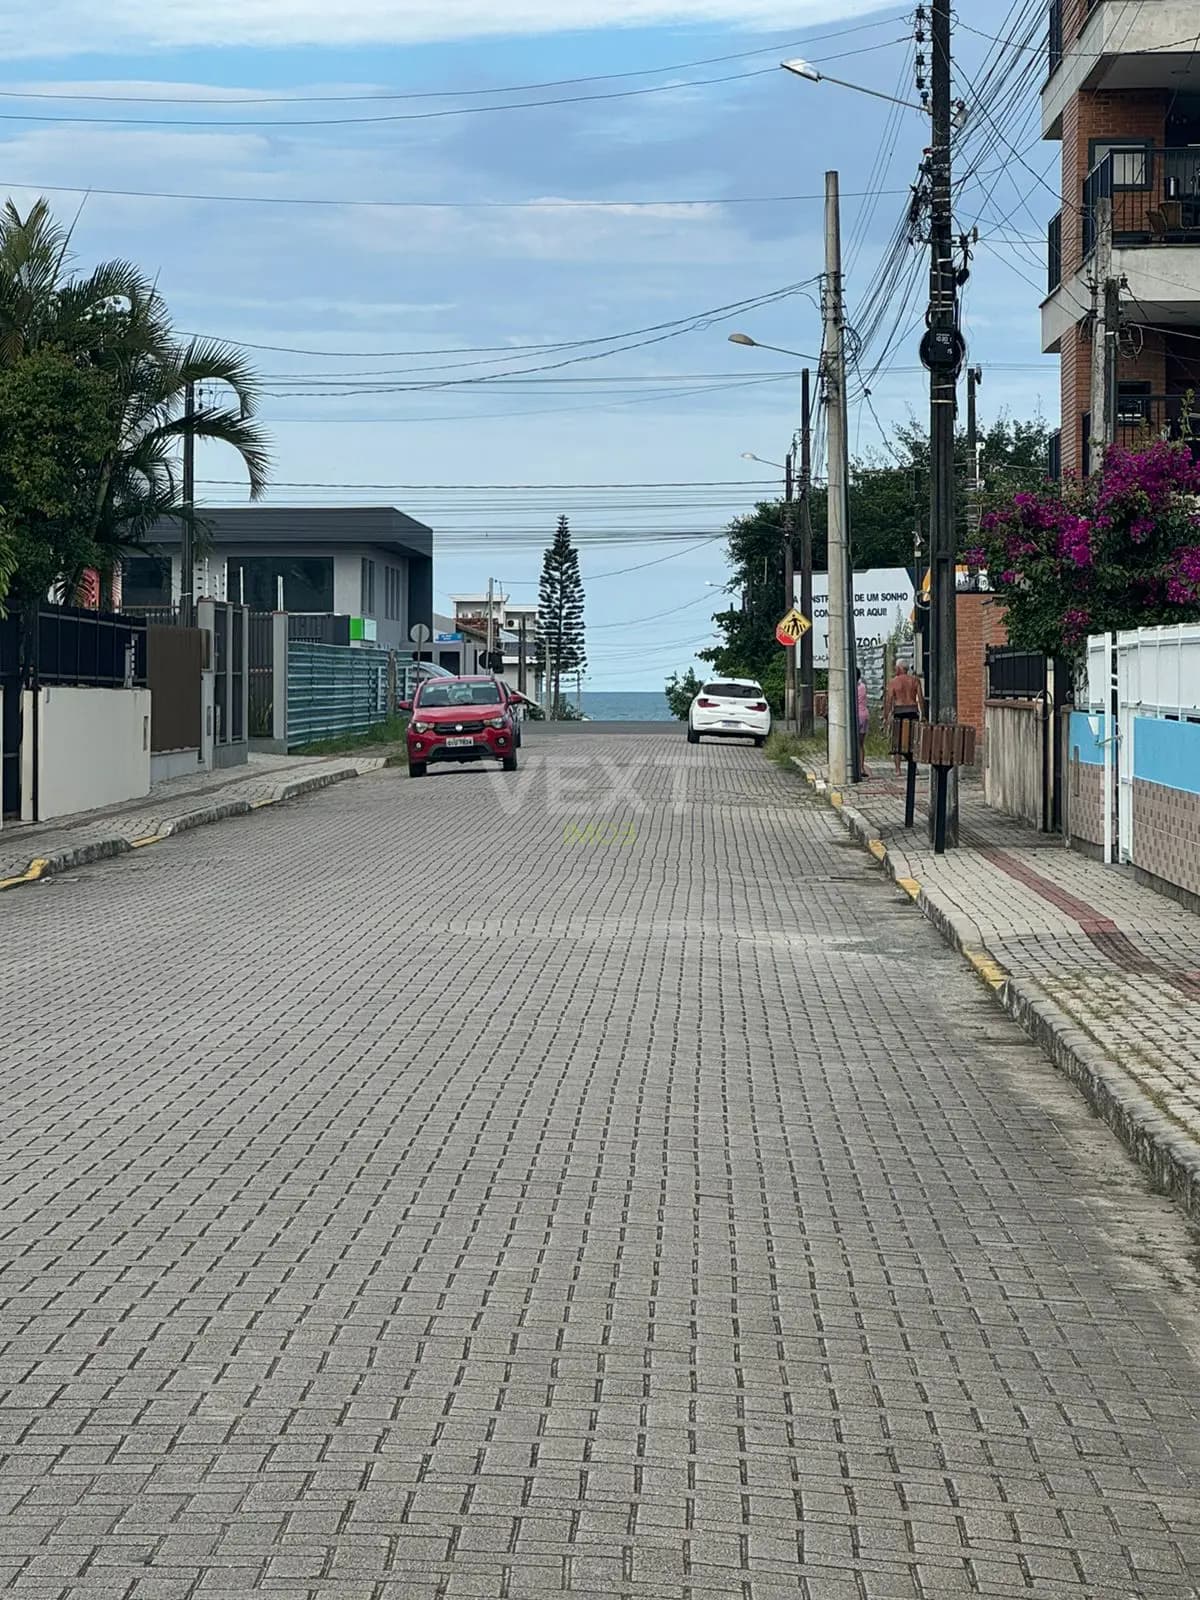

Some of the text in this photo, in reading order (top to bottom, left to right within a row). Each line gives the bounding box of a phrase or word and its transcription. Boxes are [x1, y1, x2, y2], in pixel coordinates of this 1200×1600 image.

[854, 593, 865, 602] DE
[866, 593, 879, 602] UM
[880, 592, 909, 602] SONHO
[852, 608, 865, 617] OR
